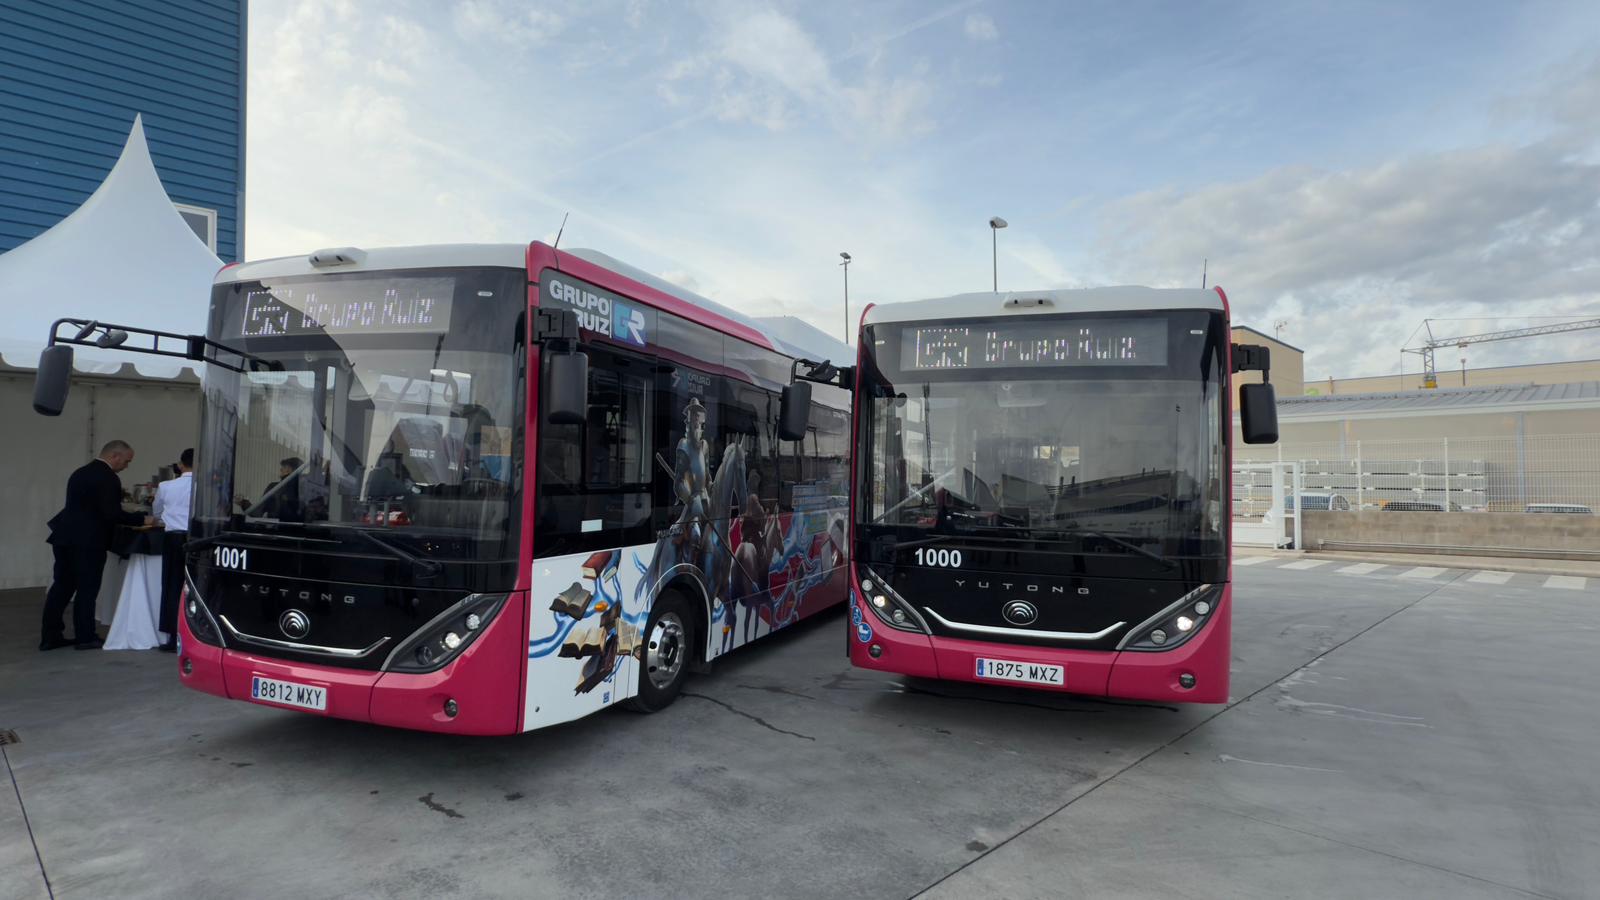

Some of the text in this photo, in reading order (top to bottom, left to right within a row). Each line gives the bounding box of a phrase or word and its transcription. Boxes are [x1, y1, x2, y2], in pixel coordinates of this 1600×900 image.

[549, 280, 610, 315] GRUPO
[214, 546, 247, 570] 1001
[914, 548, 962, 568] 1000
[241, 584, 355, 604] YUTONG
[955, 579, 1090, 595] YUTONG
[988, 661, 1058, 682] 1875 MXZ
[261, 681, 322, 706] 8812 MXY
